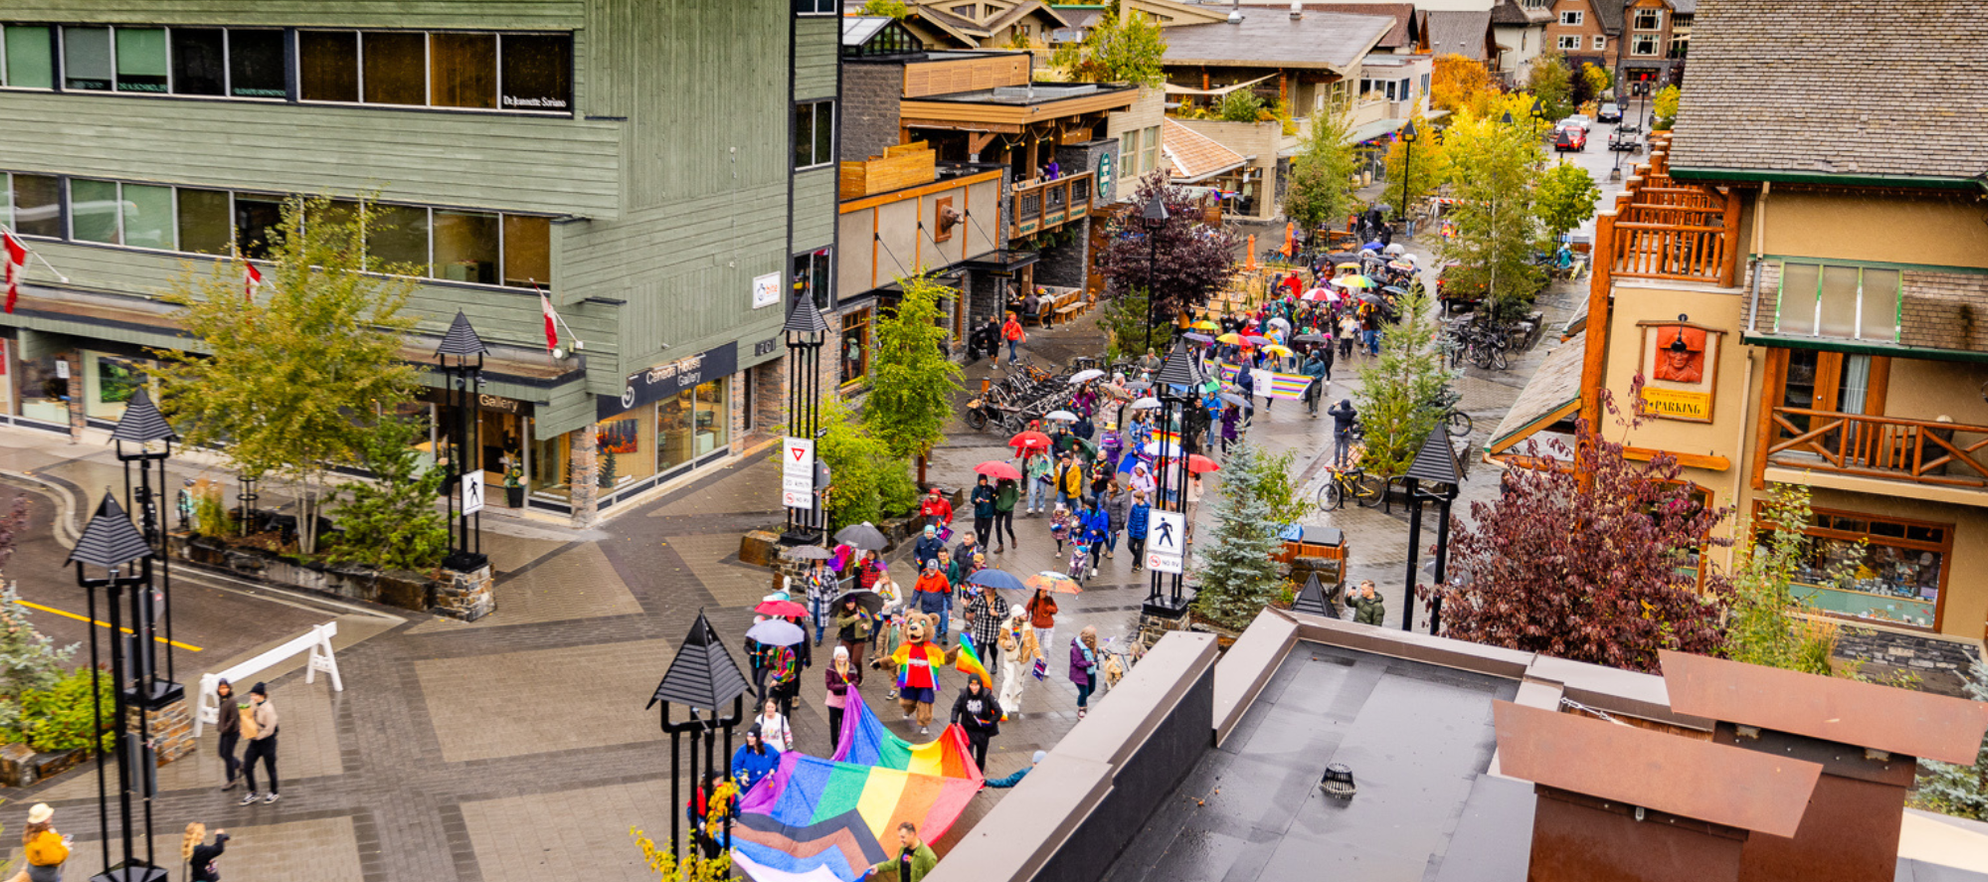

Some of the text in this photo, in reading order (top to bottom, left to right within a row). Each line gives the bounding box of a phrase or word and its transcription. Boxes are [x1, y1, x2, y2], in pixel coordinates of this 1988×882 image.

[541, 97, 566, 107] Soriano
[760, 340, 775, 354] 201
[646, 358, 701, 385] Canada House
[677, 371, 701, 387] Gallery
[479, 393, 518, 413] Gallery
[1655, 400, 1701, 414] PARKING
